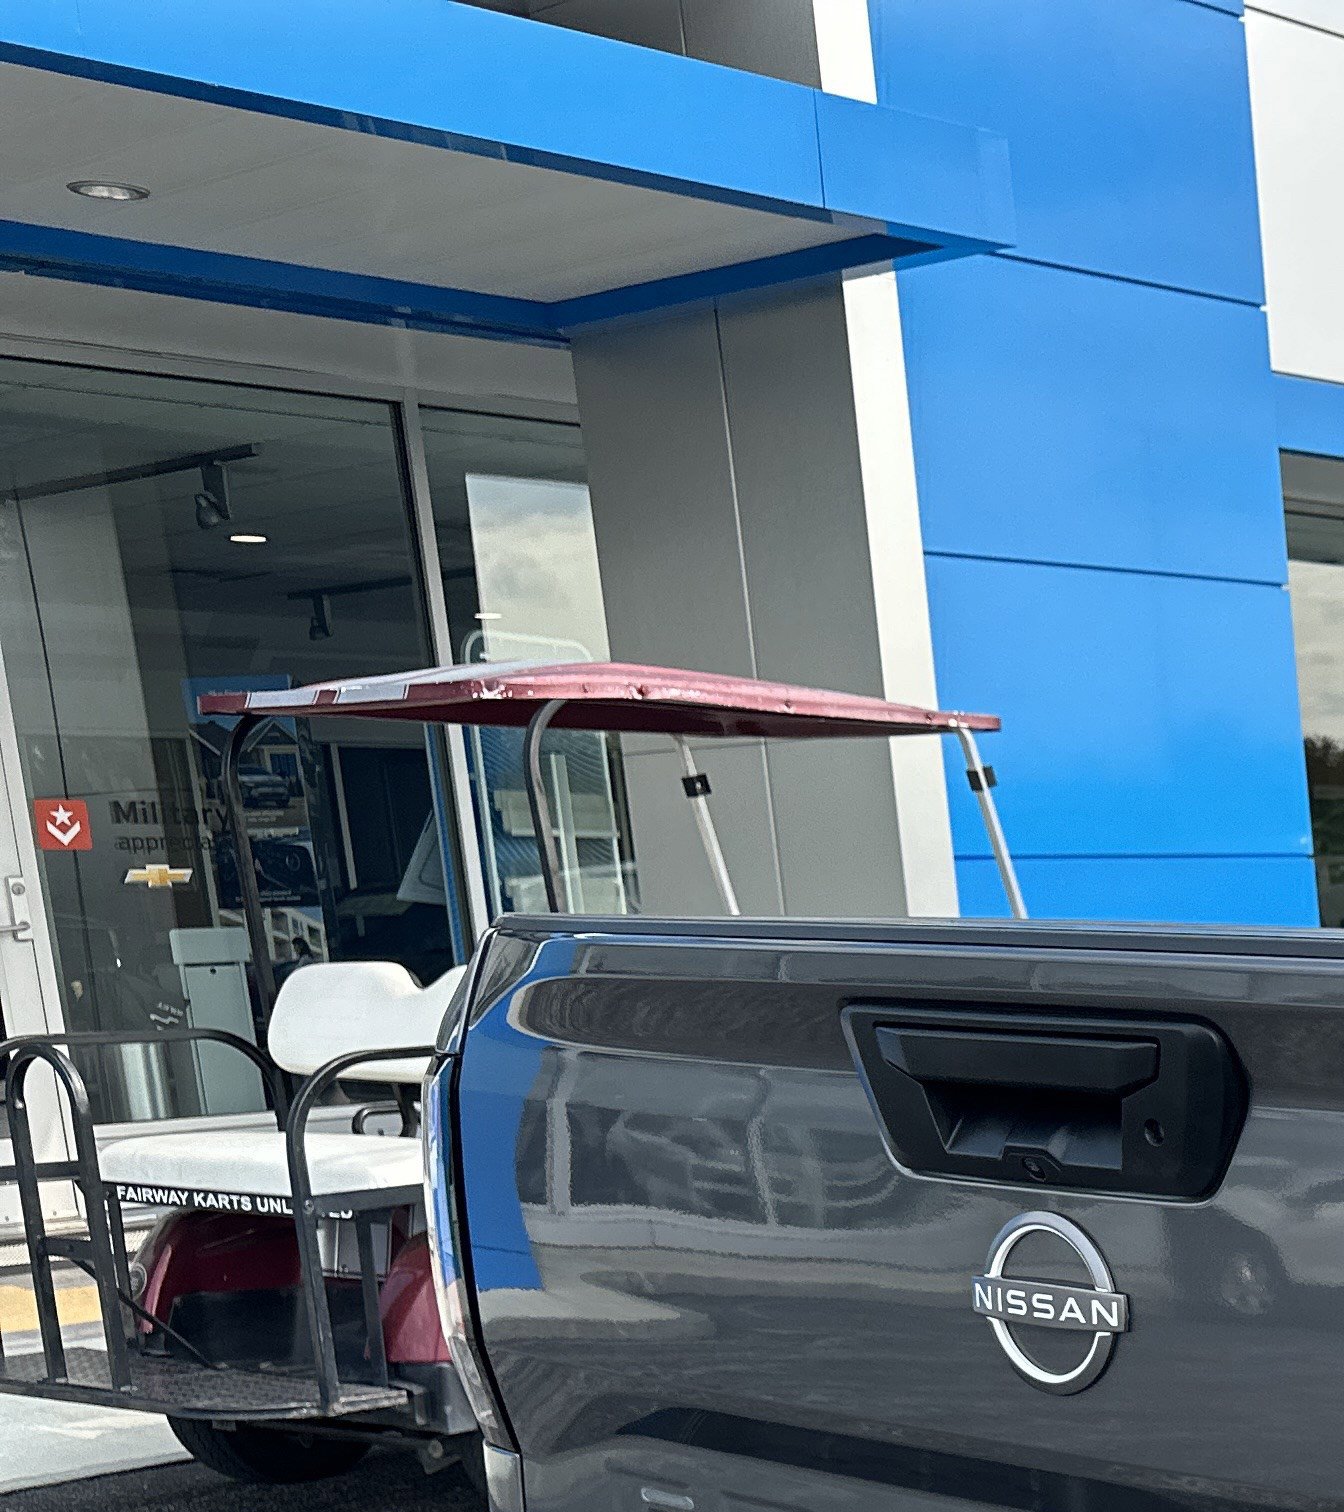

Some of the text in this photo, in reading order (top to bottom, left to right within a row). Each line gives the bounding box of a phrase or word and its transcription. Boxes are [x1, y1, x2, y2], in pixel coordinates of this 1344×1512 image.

[117, 1185, 189, 1207] FAIRWAY
[193, 1192, 252, 1212] KARTS
[974, 1283, 1118, 1327] NISSAN
